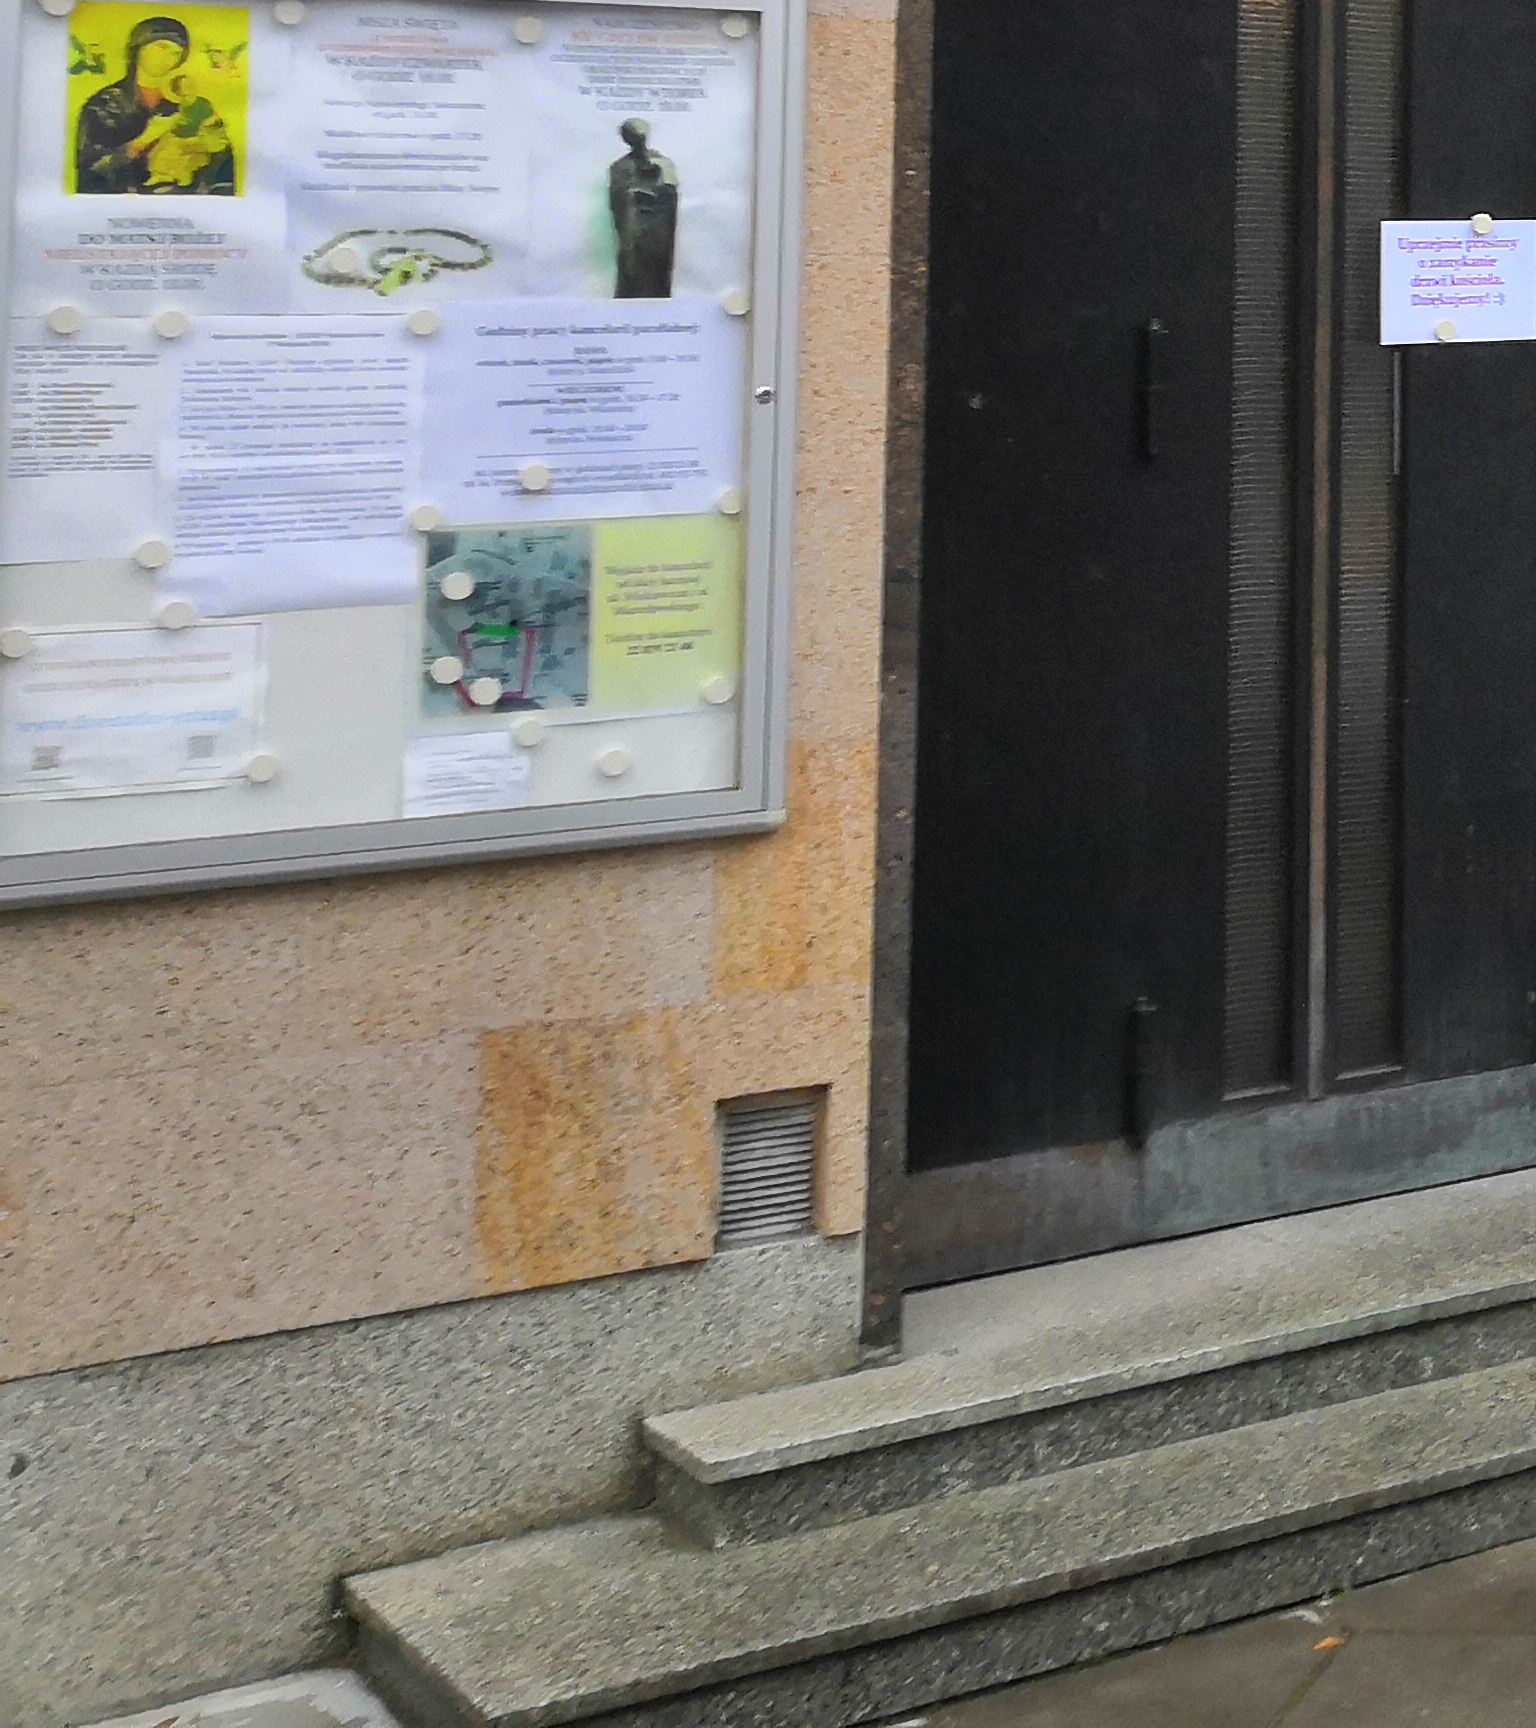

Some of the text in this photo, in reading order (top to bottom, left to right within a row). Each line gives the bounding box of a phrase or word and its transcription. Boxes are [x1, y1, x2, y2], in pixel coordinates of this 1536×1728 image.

[1397, 237, 1520, 253] Uprzejmie prosimy
[1429, 255, 1498, 271] zamykanie
[1410, 274, 1447, 287] drzwi
